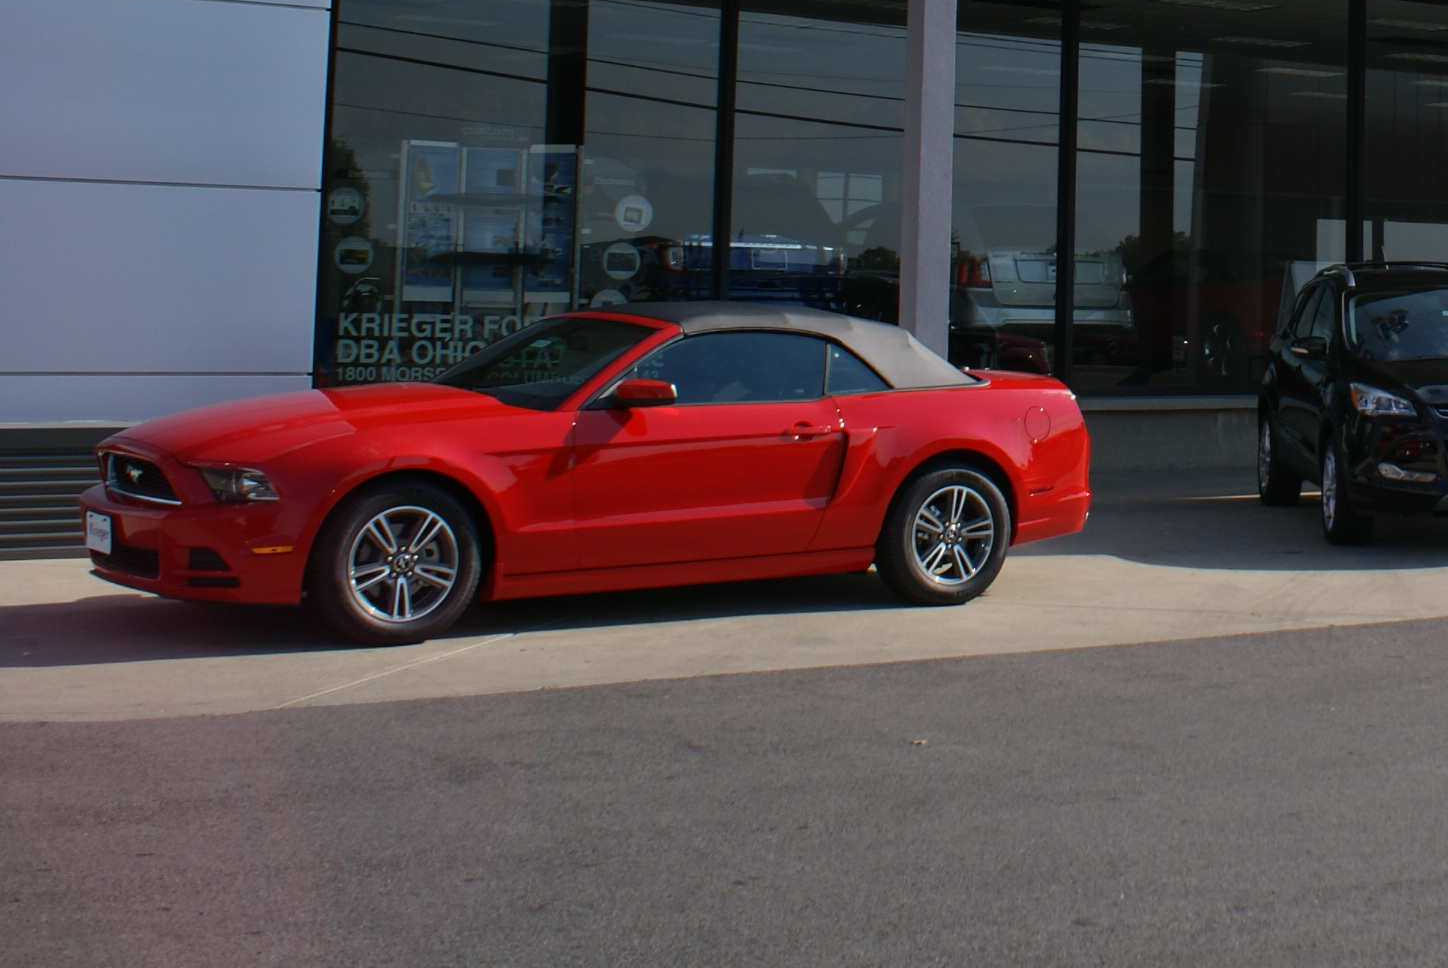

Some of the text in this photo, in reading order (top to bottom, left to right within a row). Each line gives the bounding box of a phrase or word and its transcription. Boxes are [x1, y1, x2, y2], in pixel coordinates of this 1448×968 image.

[338, 311, 474, 339] KRIEGER
[336, 339, 402, 364] DBA
[336, 366, 377, 382] 1800
